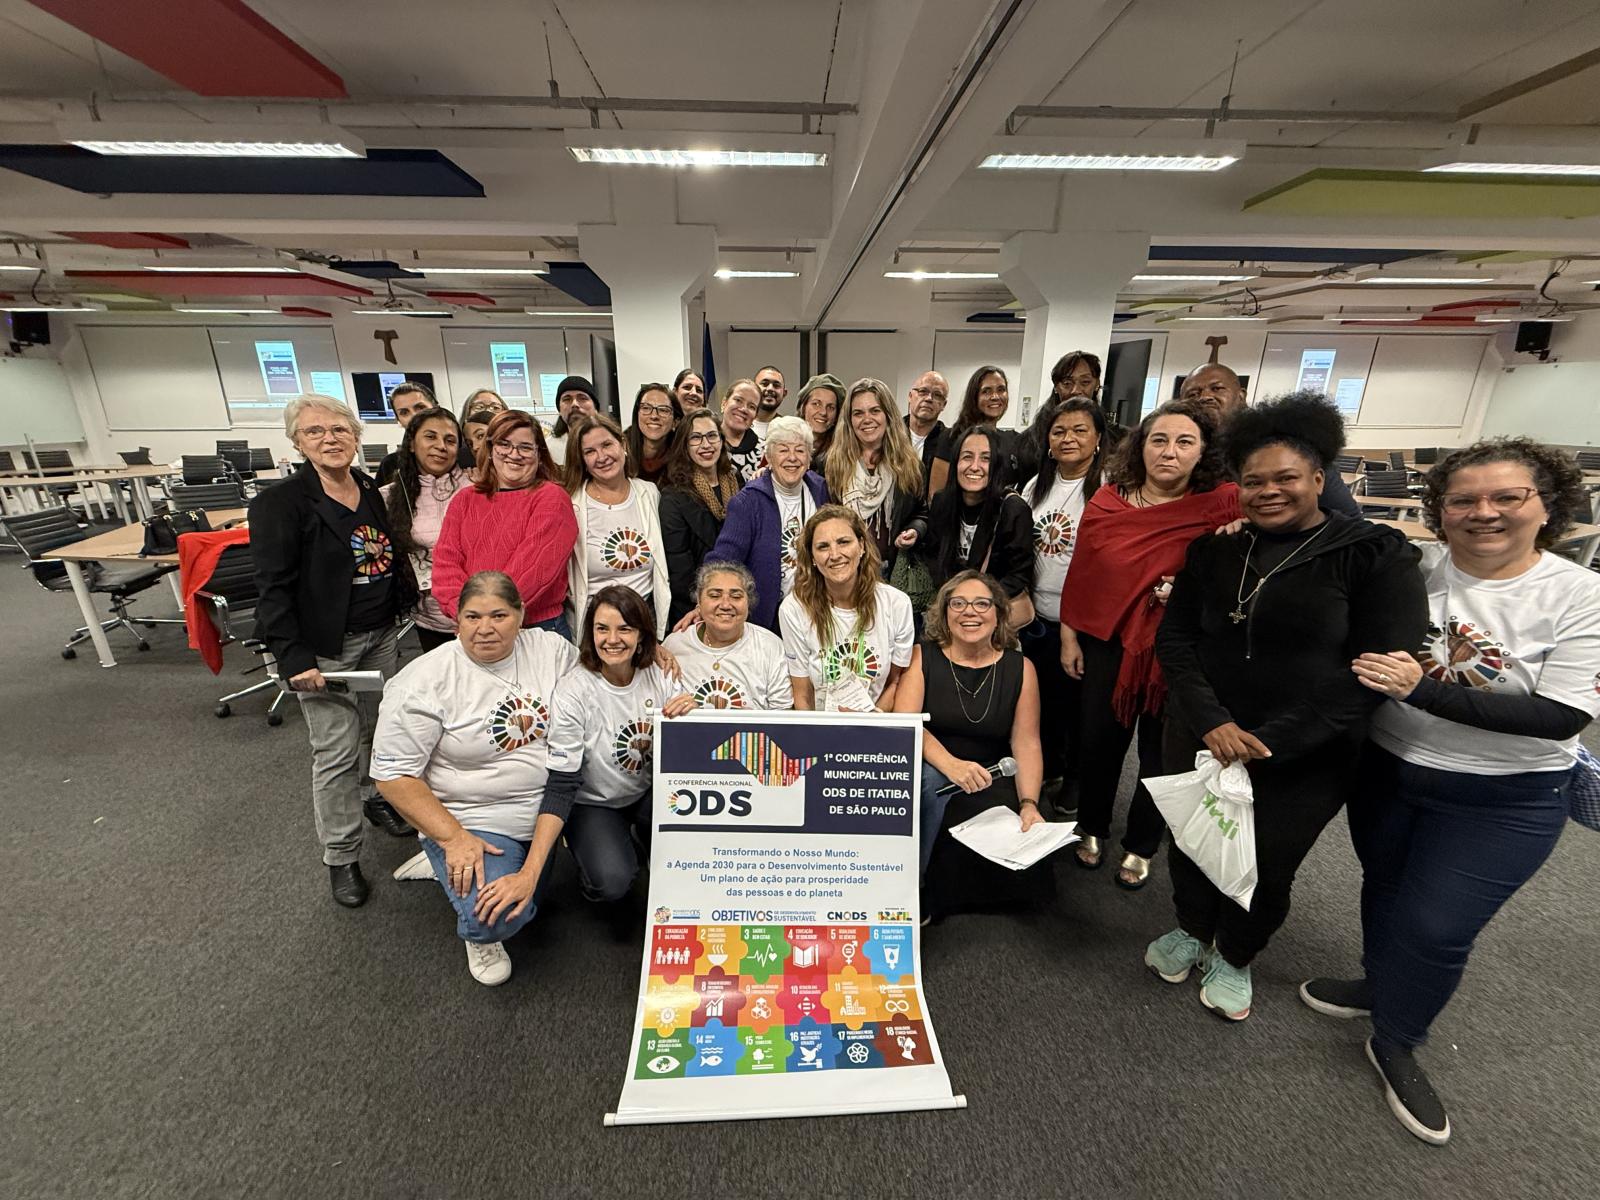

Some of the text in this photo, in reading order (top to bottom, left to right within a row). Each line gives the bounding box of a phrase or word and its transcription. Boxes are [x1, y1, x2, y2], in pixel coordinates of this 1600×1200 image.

[824, 752, 908, 764] 1ª CONFERÊNCIA
[824, 770, 910, 781] MUNICIPAL LIVRE
[822, 788, 910, 799] ODS DE ITATIBA
[666, 789, 752, 817] ODS
[829, 804, 906, 816] DE SÃO PAULO
[712, 848, 782, 856] Transformando
[793, 849, 822, 857] Nosso
[825, 849, 859, 858] Mundo:
[675, 860, 710, 870] Agenda
[768, 862, 847, 871] Desenvolvimento
[850, 862, 903, 872] Sustentável
[700, 874, 715, 882] Um
[719, 874, 744, 884] plano
[761, 875, 782, 884] ação
[785, 876, 805, 885] para
[808, 875, 869, 885] prosperidade
[726, 888, 742, 896] das
[746, 890, 784, 898] pessoas
[810, 889, 842, 898] planeta
[712, 910, 773, 921] OBJETIVOS
[827, 911, 867, 920] CNODS
[657, 928, 662, 940] 1
[701, 928, 706, 940] 2
[744, 928, 750, 940] 3
[788, 929, 793, 940] 4
[831, 929, 836, 940] 5
[702, 981, 706, 991] 8
[745, 984, 750, 994] 9
[791, 985, 798, 995] 10
[835, 982, 840, 992] 11
[790, 1032, 799, 1041] 16
[838, 1031, 845, 1040] 17
[885, 1027, 894, 1036] 18
[696, 1035, 703, 1044] 14
[745, 1036, 753, 1045] 15
[648, 1040, 656, 1050] 13
